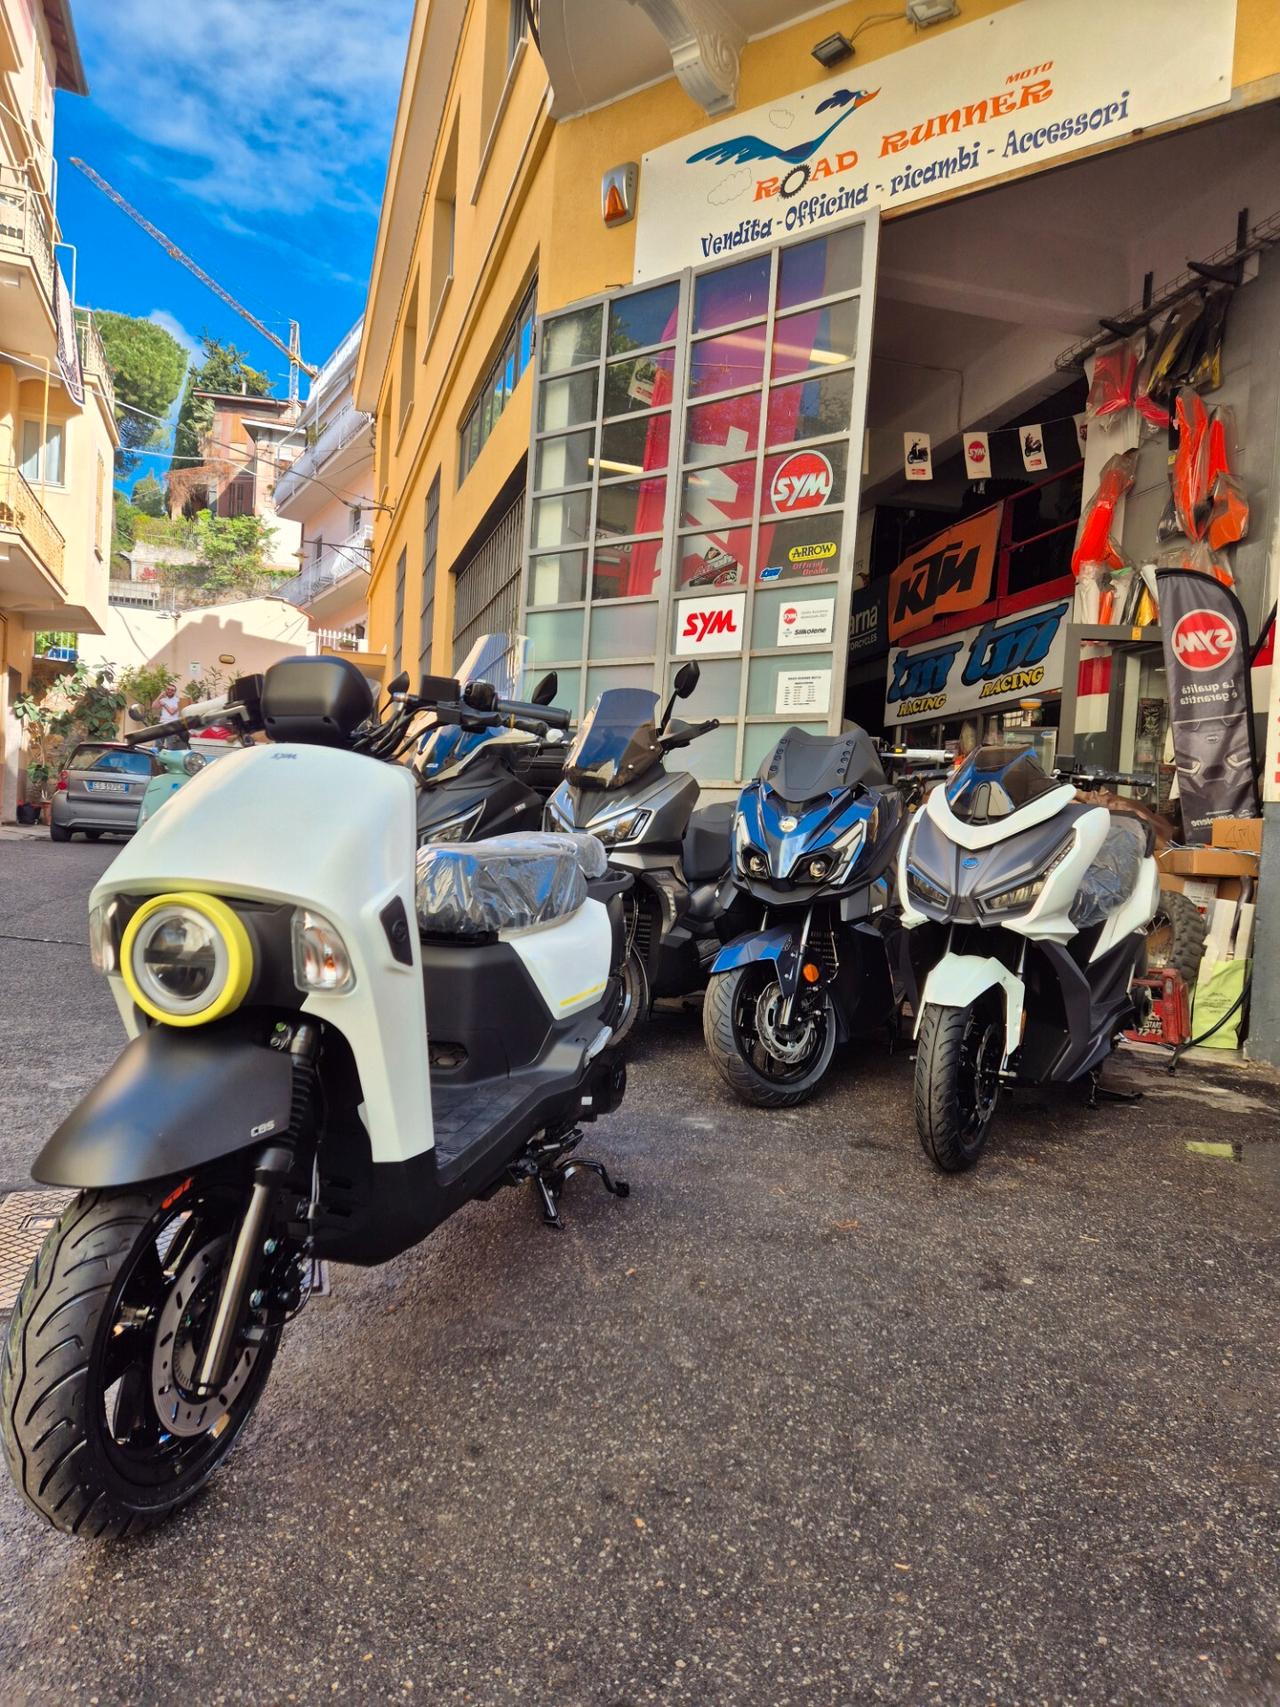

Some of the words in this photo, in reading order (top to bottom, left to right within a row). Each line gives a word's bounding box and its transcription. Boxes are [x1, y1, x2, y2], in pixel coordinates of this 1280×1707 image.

[1005, 60, 1055, 85] MOTO
[753, 150, 859, 202] ROAD
[877, 79, 1055, 159] RUNNER
[700, 217, 774, 258] Vendita
[784, 183, 869, 232] Officina
[889, 141, 981, 197] ricambi
[1001, 89, 1131, 159] Accessori
[773, 470, 831, 507] SYM
[791, 543, 834, 559] ARROW
[893, 540, 982, 625] KTM
[682, 608, 737, 643] SYM
[887, 641, 964, 704] tm
[960, 602, 1070, 687] tm
[896, 693, 948, 718] RACING
[978, 666, 1045, 699] RACING
[250, 1119, 276, 1138] CBS
